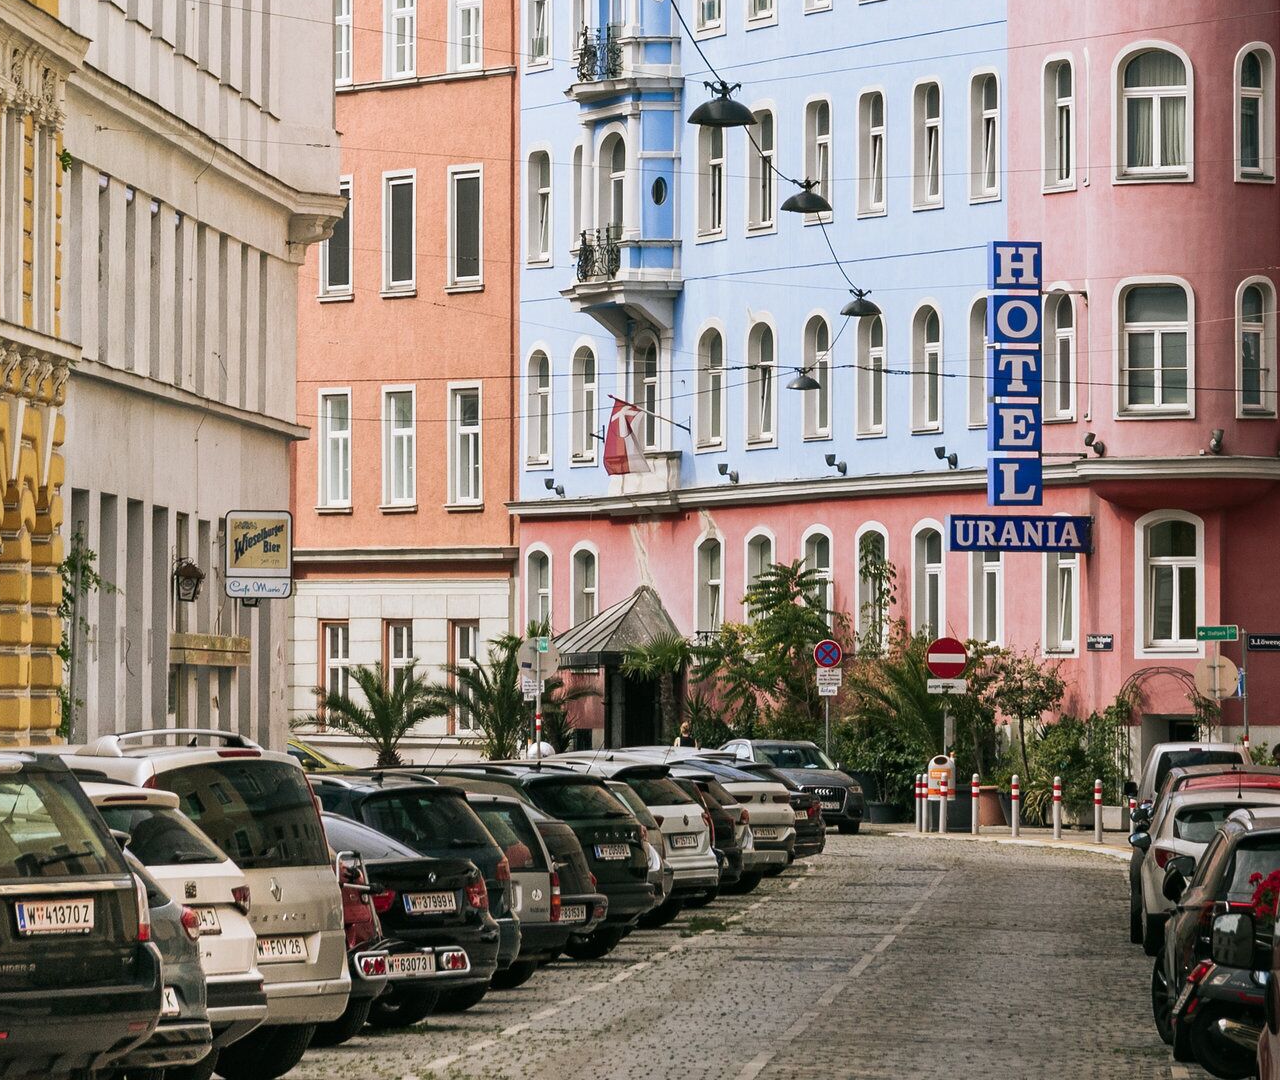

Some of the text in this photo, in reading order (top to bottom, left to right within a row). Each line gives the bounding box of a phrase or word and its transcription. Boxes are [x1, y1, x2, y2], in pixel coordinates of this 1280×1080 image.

[996, 246, 1039, 501] HOTEL
[234, 524, 285, 565] Wieselburger
[954, 520, 1081, 547] URANIA
[262, 540, 281, 553] Bier
[282, 582, 289, 596] 7
[27, 908, 36, 925] W
